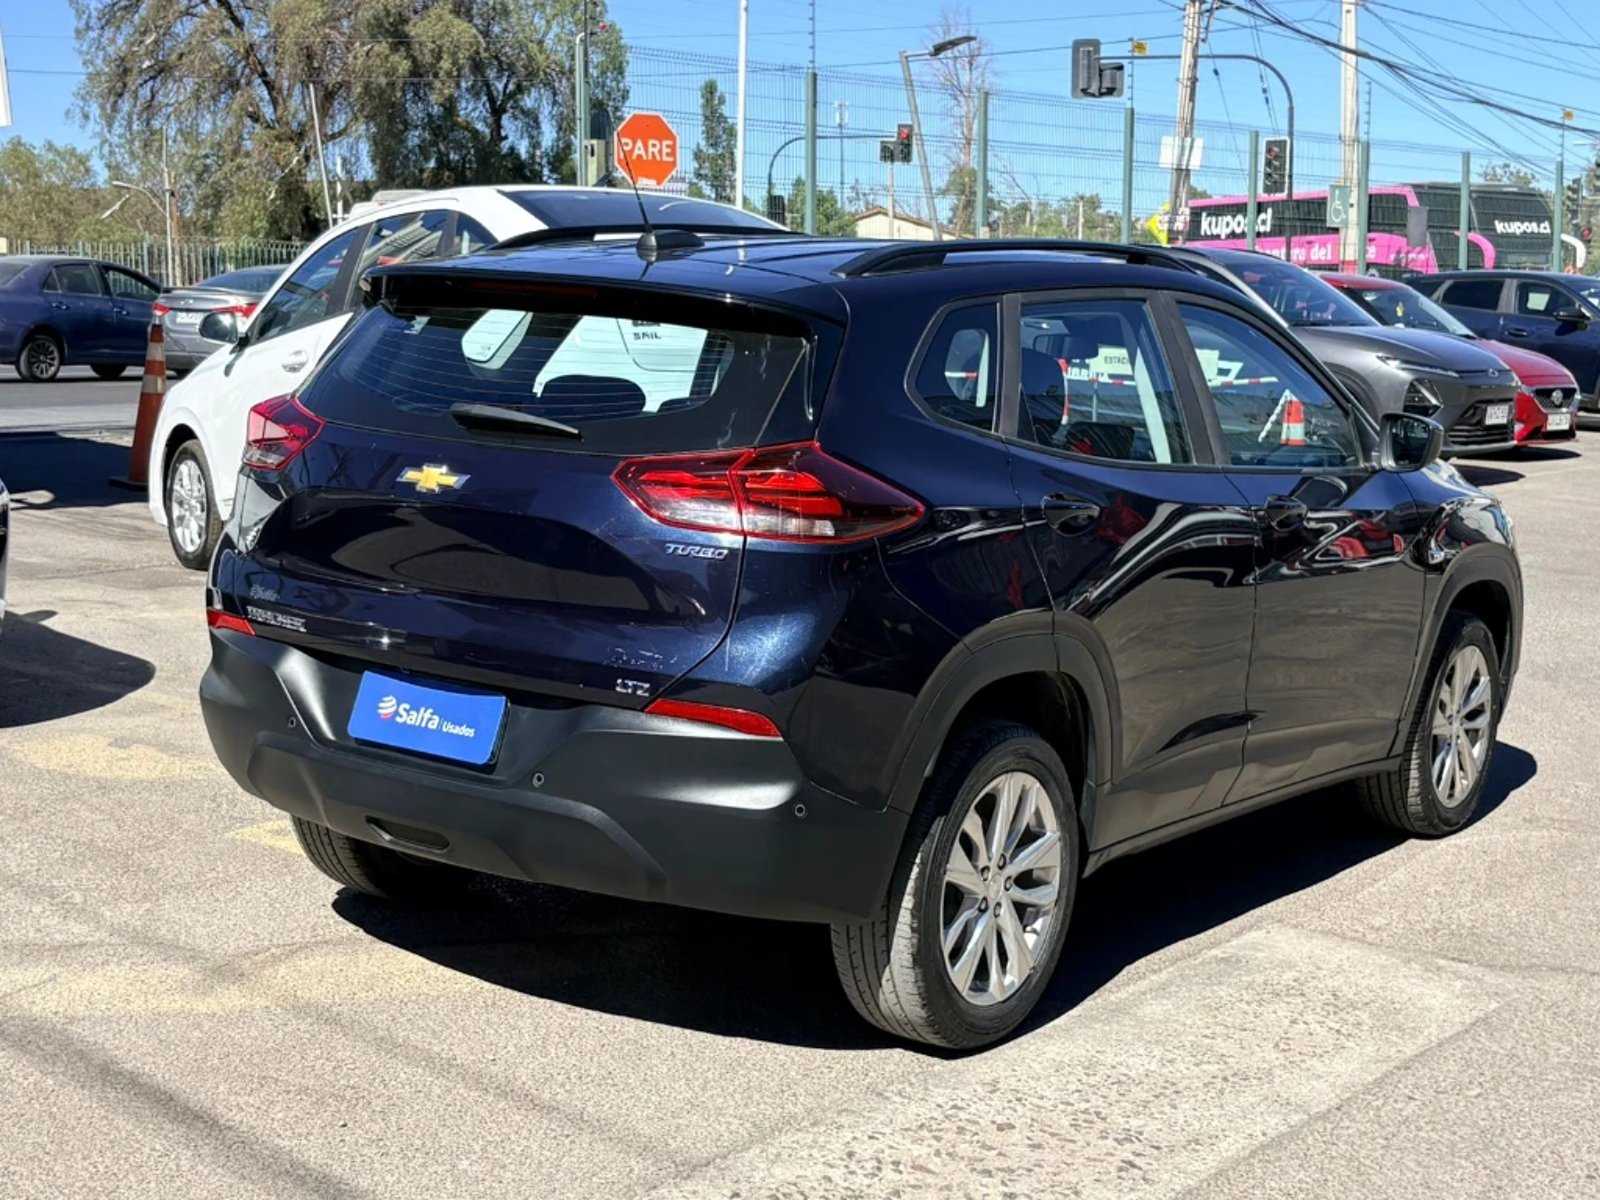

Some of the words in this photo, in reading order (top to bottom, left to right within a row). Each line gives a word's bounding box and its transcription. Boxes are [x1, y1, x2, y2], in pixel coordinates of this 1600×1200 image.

[619, 138, 674, 161] PARE
[1310, 243, 1332, 260] del
[665, 543, 728, 559] TURBO
[615, 678, 650, 696] LTZ
[395, 703, 440, 730] Salfa
[442, 721, 475, 738] Usados
